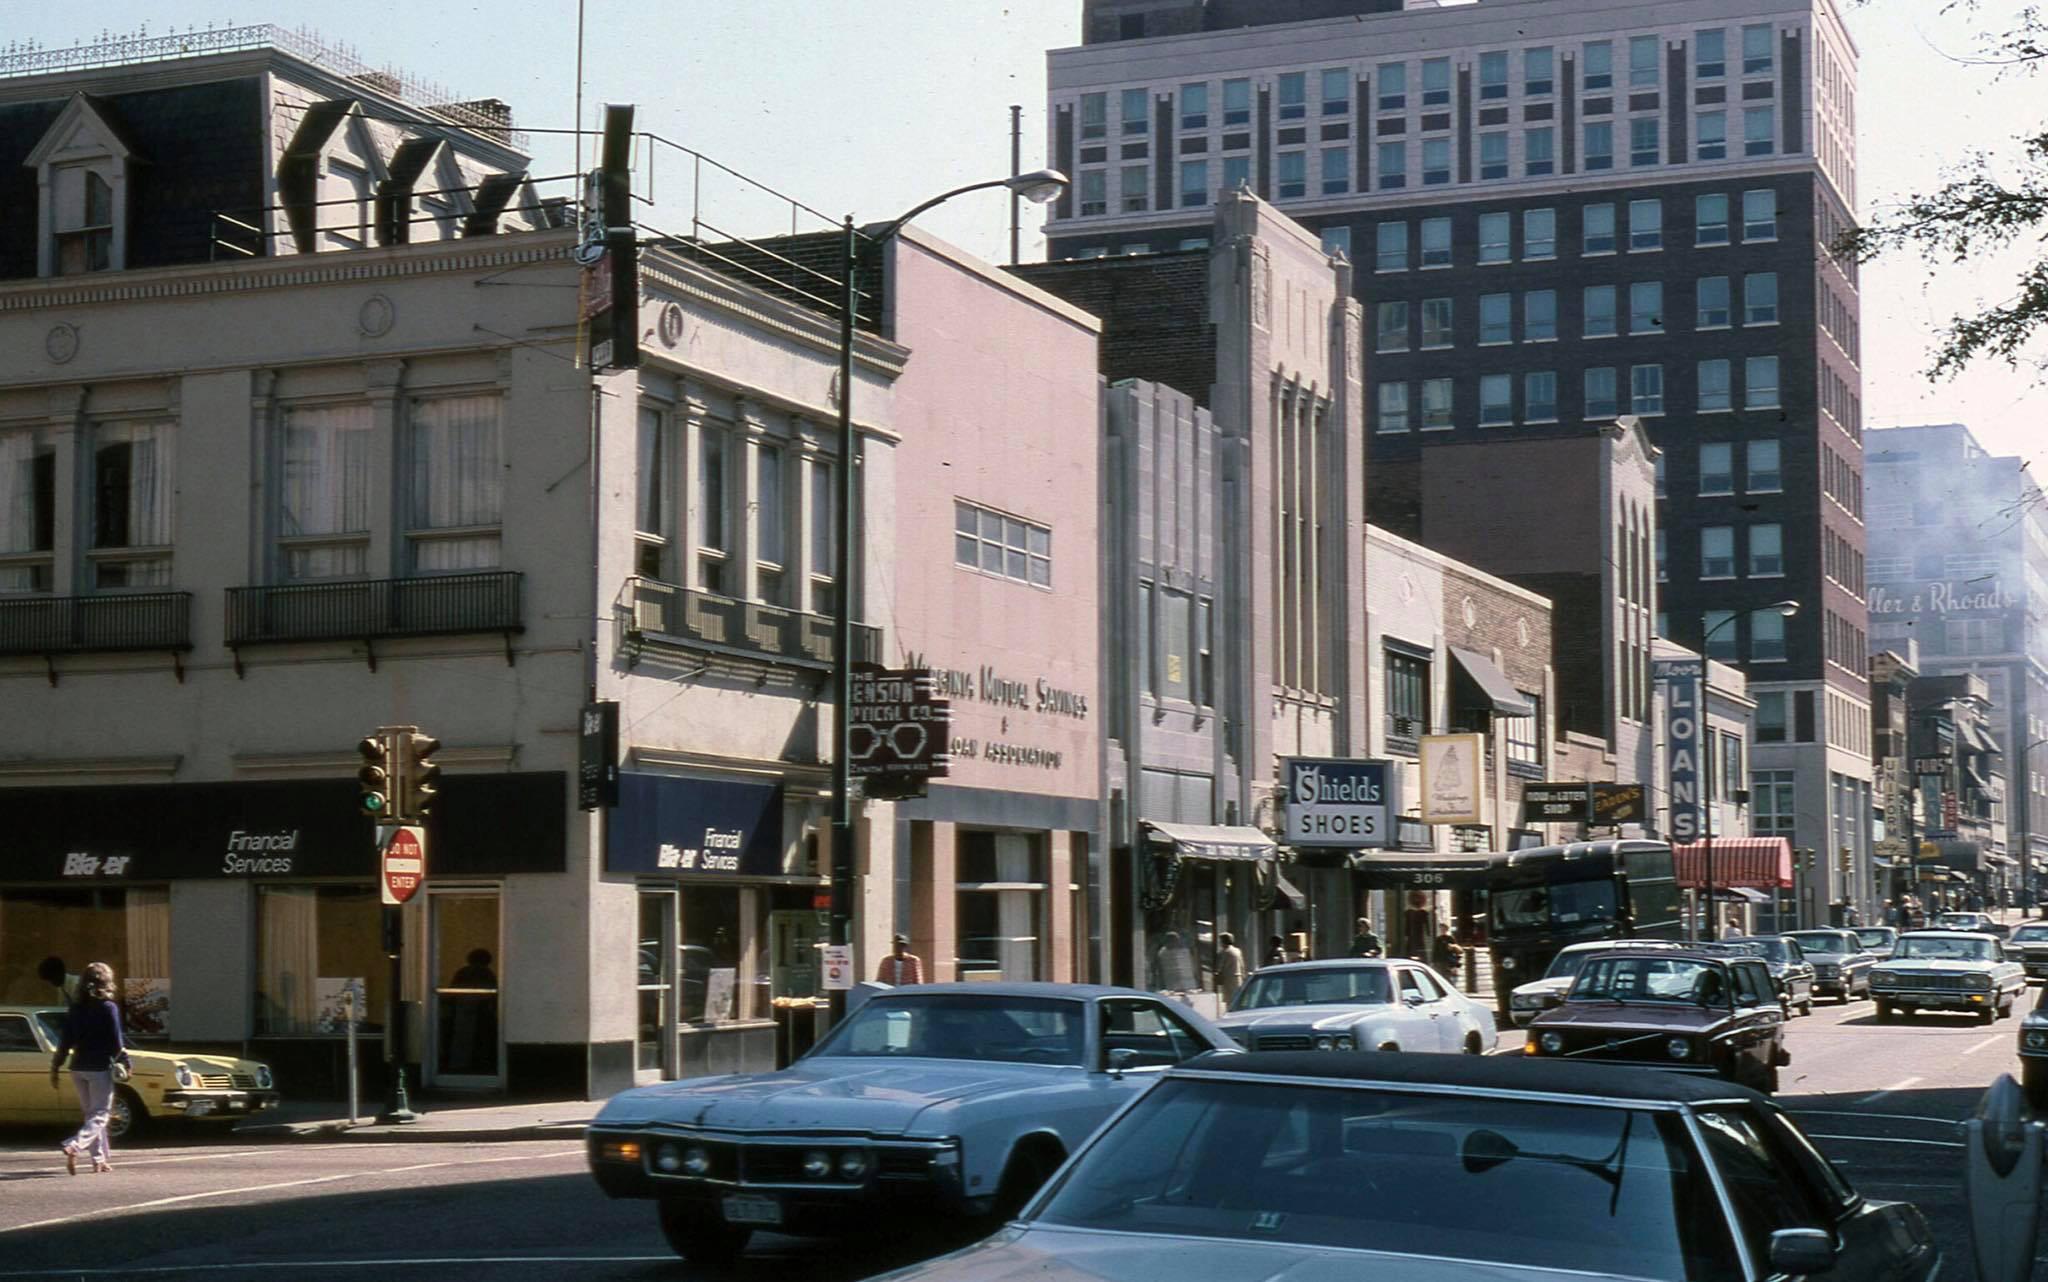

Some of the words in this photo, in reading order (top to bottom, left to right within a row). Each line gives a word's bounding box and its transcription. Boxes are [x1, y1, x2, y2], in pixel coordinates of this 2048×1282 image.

[1867, 587, 1904, 613] ller
[1911, 594, 1921, 613] &
[1928, 581, 2017, 614] Rhoads
[848, 672, 873, 681] THE
[1654, 662, 1702, 676] Moor
[852, 681, 913, 703] ENSON
[1036, 677, 1088, 720] SAVINGS
[850, 705, 904, 721] PTICAL
[984, 741, 1062, 769] ASSOCIATION
[1671, 685, 1695, 837] LOANS
[1300, 774, 1380, 802] Shields
[1301, 814, 1375, 834] SHOES
[227, 829, 299, 851] Financial
[389, 842, 400, 855] DO
[403, 843, 418, 855] NOT
[703, 827, 742, 849] Financial
[222, 852, 292, 874] Services
[701, 848, 739, 870] Services
[391, 876, 416, 889] ENTER
[1413, 873, 1445, 884] 306
